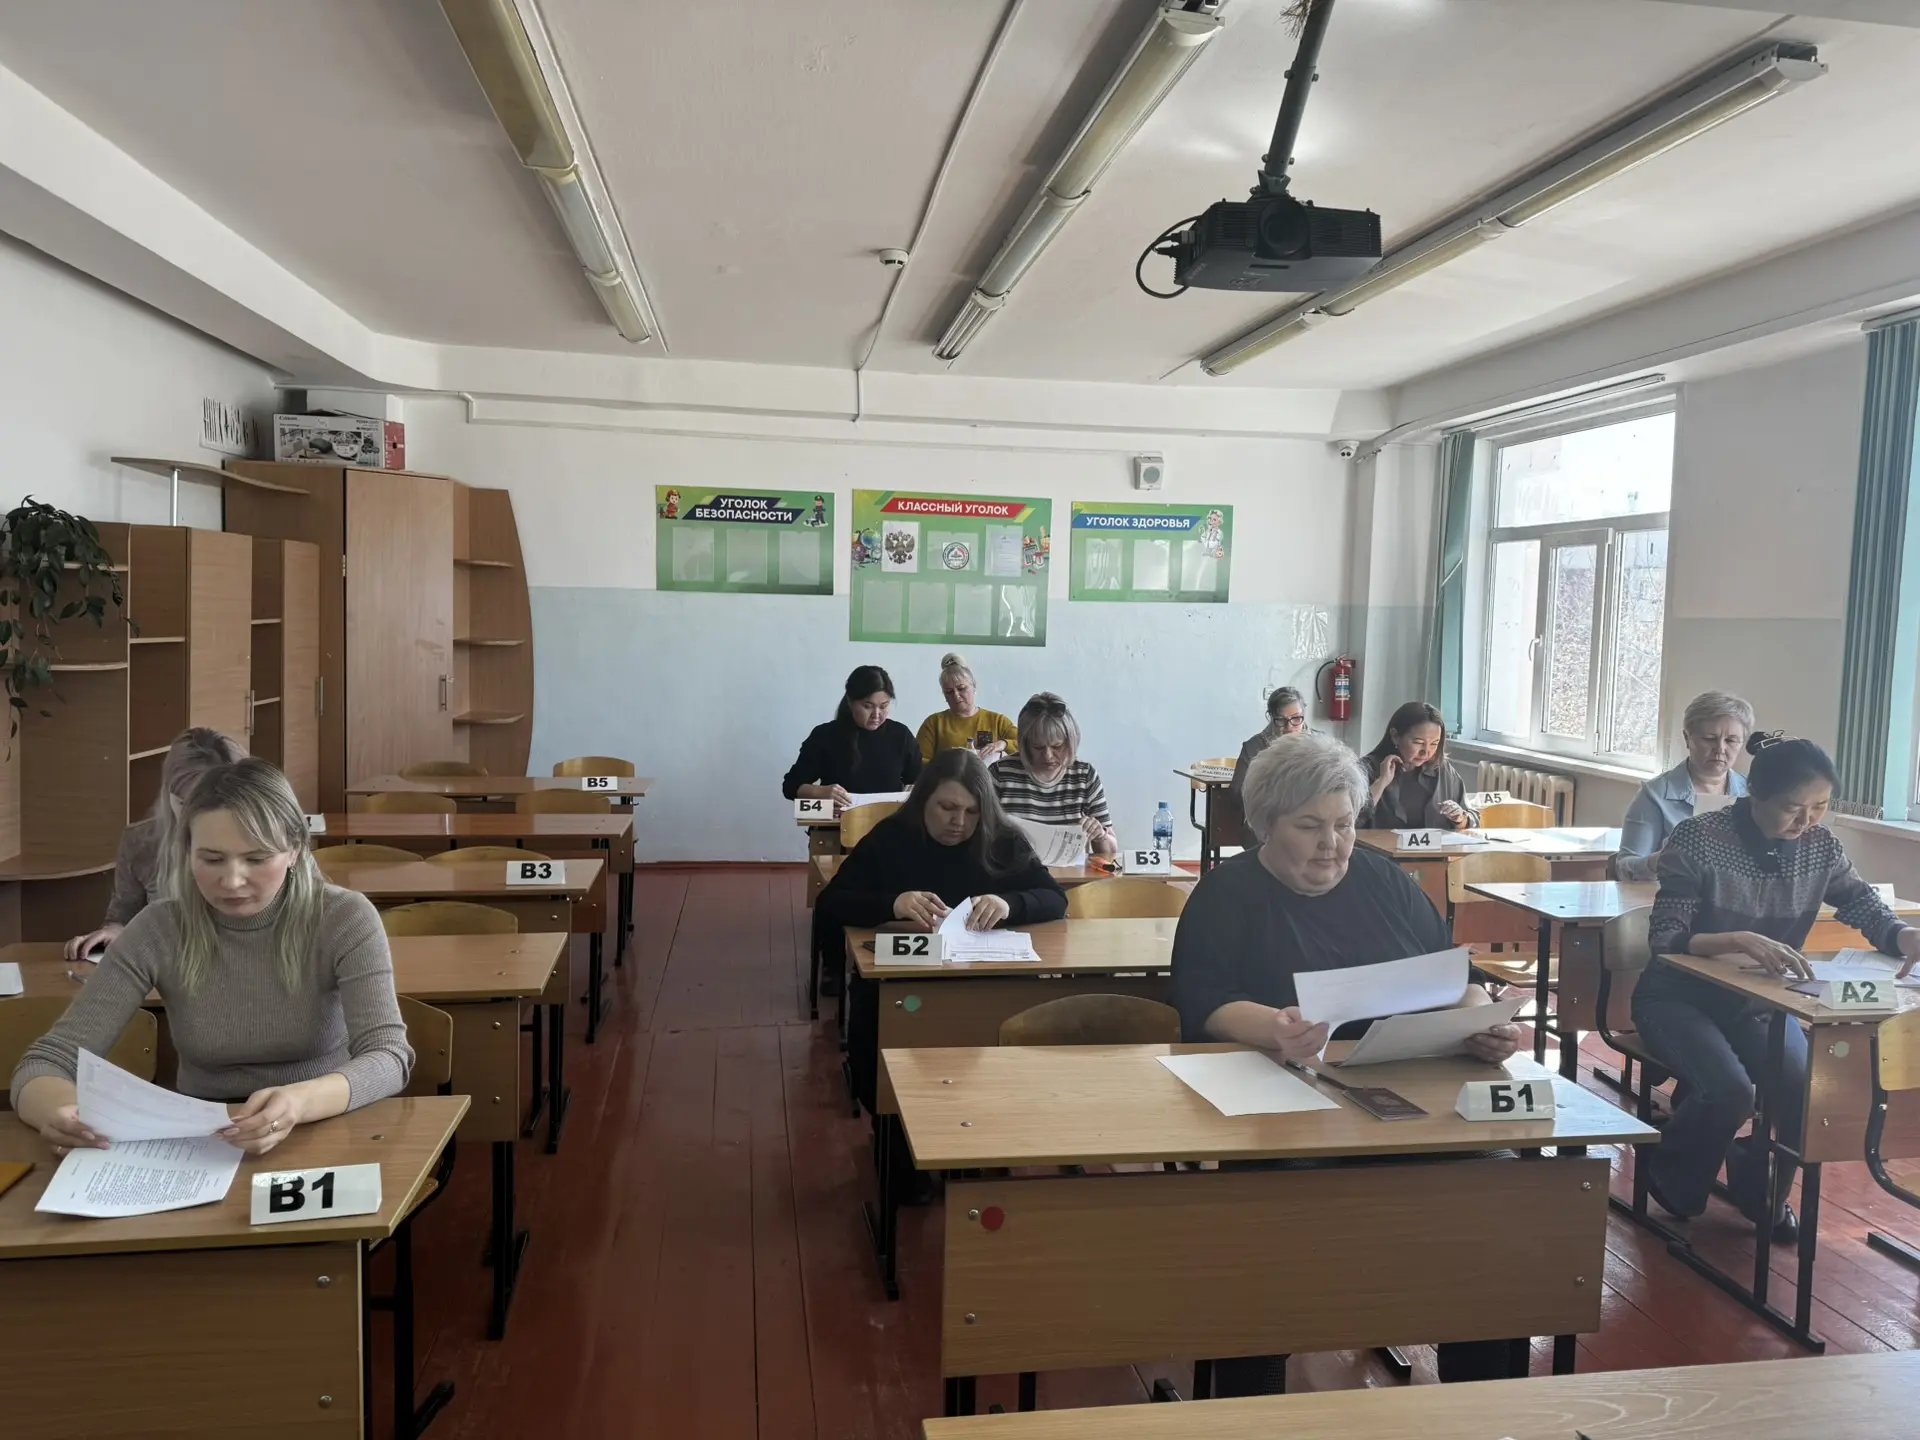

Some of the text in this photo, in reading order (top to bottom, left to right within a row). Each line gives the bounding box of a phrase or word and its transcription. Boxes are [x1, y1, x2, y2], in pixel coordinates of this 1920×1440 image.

[720, 498, 768, 510] УГОЛОК
[897, 501, 1009, 515] КЛАССНЫЙ УГОЛОК
[695, 508, 793, 521] БЕЗОПАСНОСТИ
[1086, 516, 1190, 528] УГОЛОК ЗДОРОВЬЯ
[587, 777, 608, 788] В5
[1483, 793, 1502, 804] А5
[799, 800, 823, 812] Б4
[1407, 832, 1431, 847] А4
[1135, 851, 1161, 866] Б3
[520, 862, 552, 879] В3
[892, 935, 929, 956] Б2
[1841, 981, 1879, 1003] А2
[1490, 1083, 1533, 1113] Б1
[269, 1172, 336, 1213] В1
